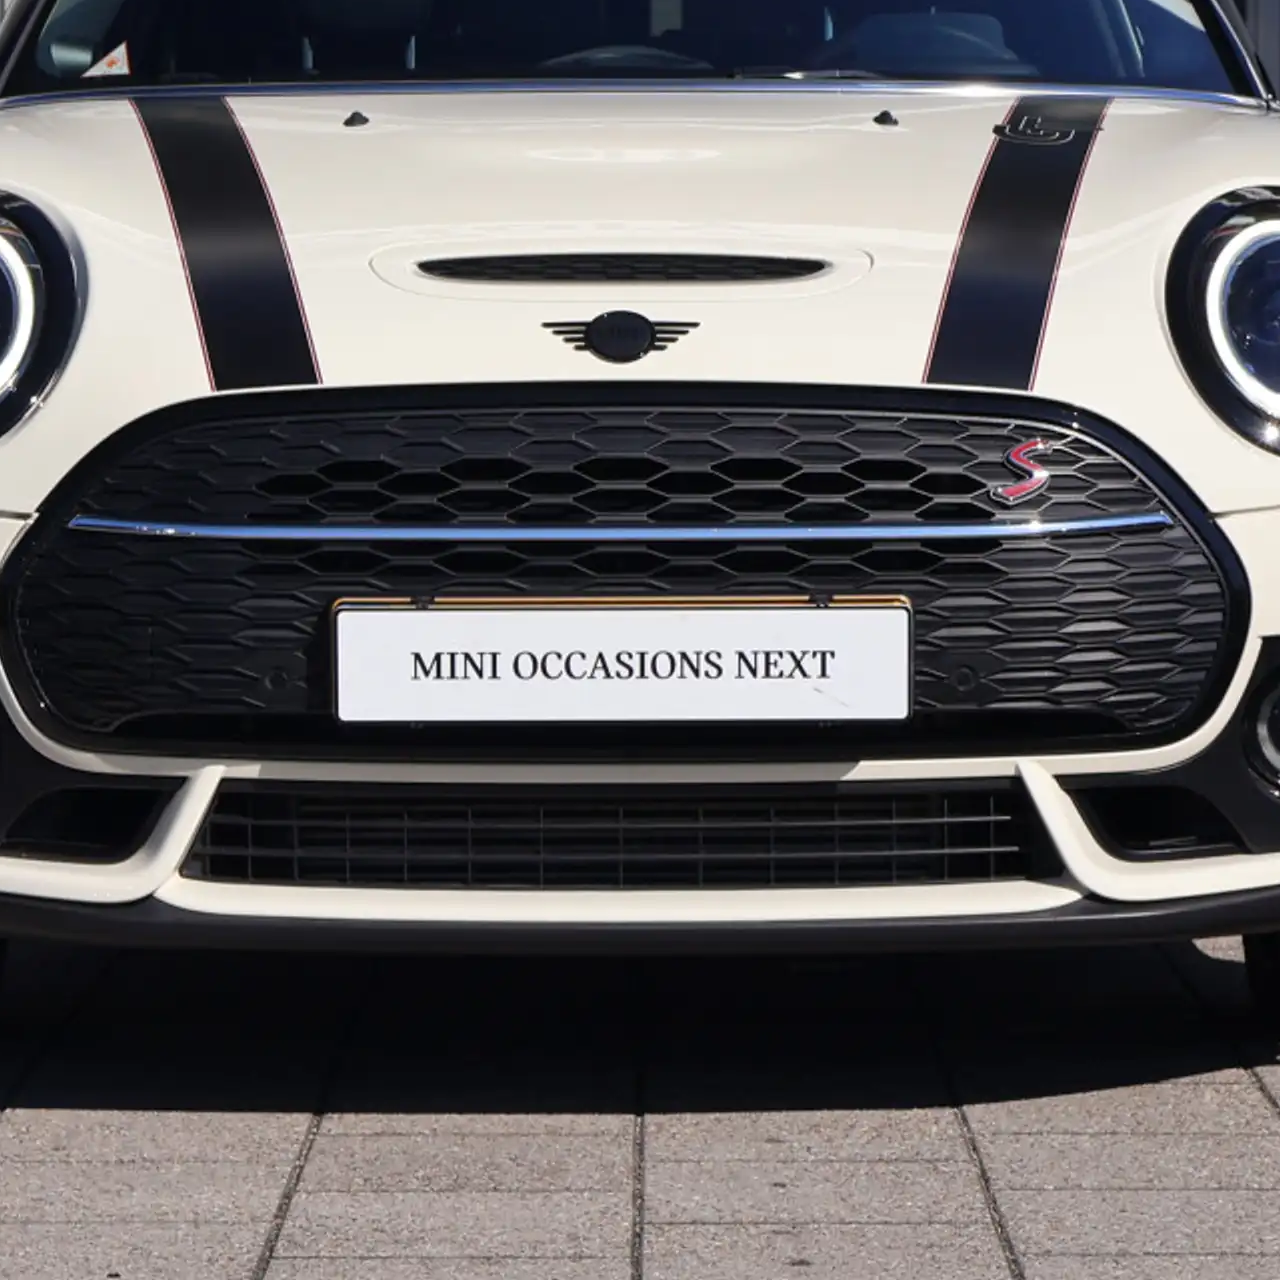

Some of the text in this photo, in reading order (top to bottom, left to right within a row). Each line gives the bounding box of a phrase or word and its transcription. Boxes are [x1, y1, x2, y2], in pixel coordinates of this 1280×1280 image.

[411, 651, 836, 680] MINI OCCASIONS NEXT
